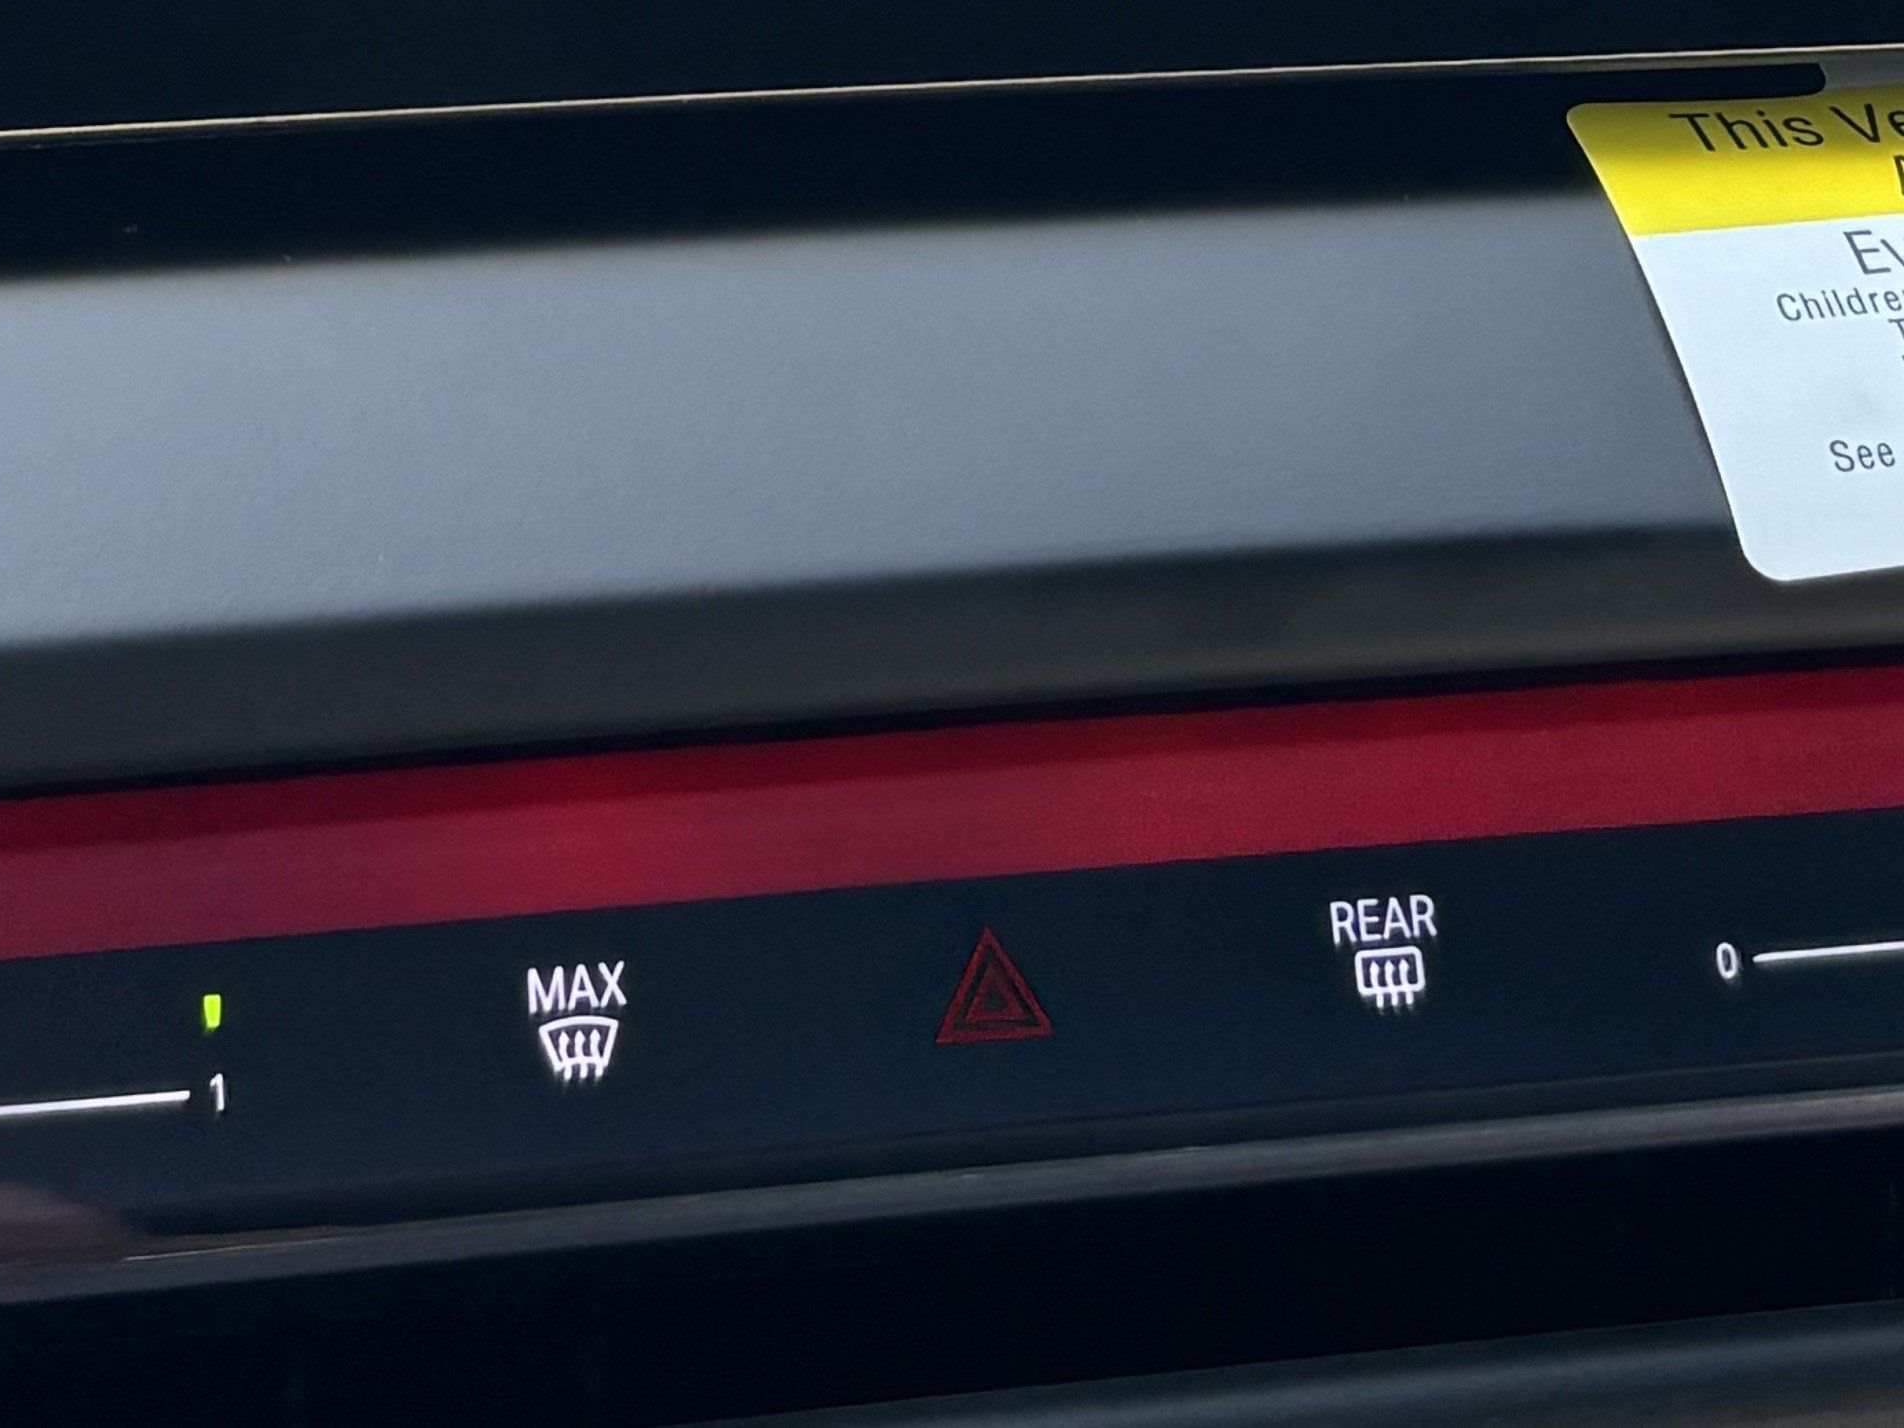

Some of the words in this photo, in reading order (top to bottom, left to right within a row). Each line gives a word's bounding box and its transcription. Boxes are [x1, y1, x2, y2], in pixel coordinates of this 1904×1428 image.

[1666, 108, 1825, 152] This
[1828, 438, 1896, 473] See
[1329, 894, 1437, 942] REAR
[1715, 941, 1739, 980] 0
[527, 960, 627, 1012] MAX
[209, 1073, 225, 1112] 1
